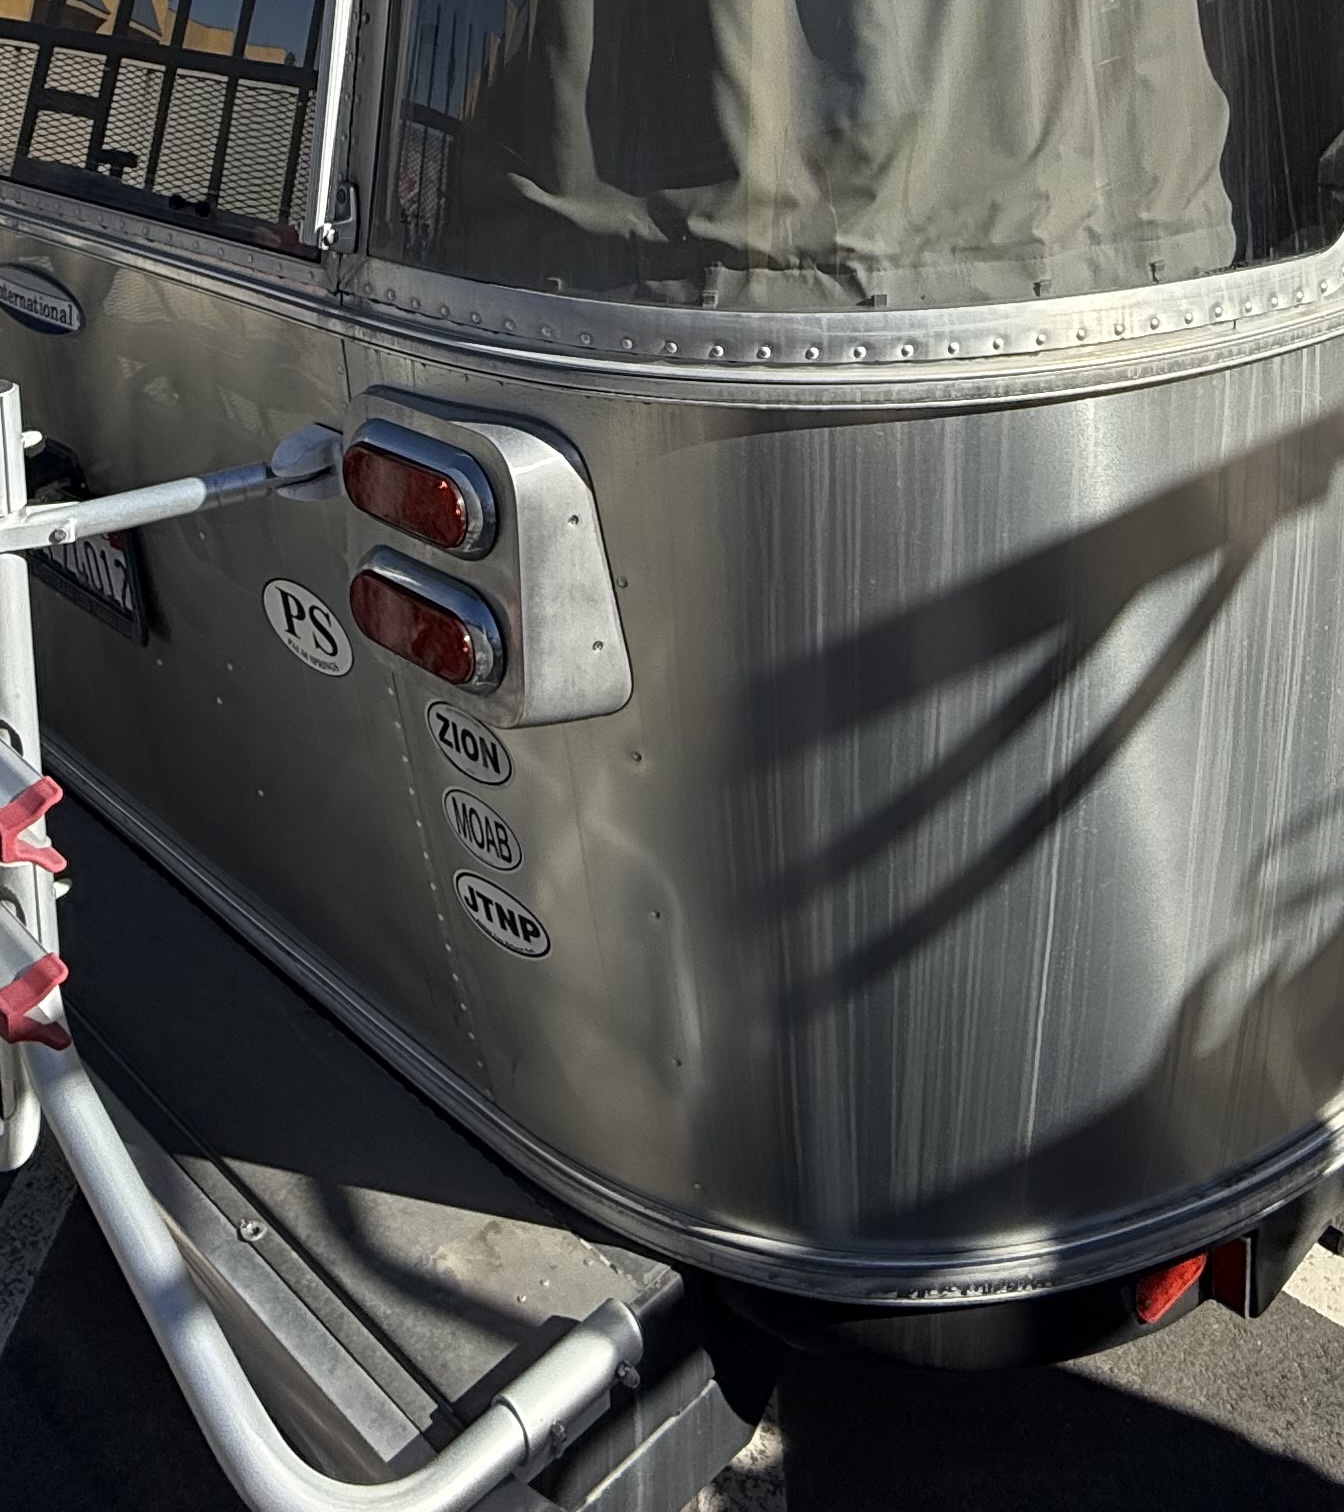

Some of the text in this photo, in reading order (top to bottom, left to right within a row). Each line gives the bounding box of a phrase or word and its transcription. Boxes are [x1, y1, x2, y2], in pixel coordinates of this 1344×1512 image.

[275, 585, 338, 657] PS
[436, 712, 501, 775] ZION
[452, 796, 513, 864] MOAB
[464, 884, 541, 943] JTNP
